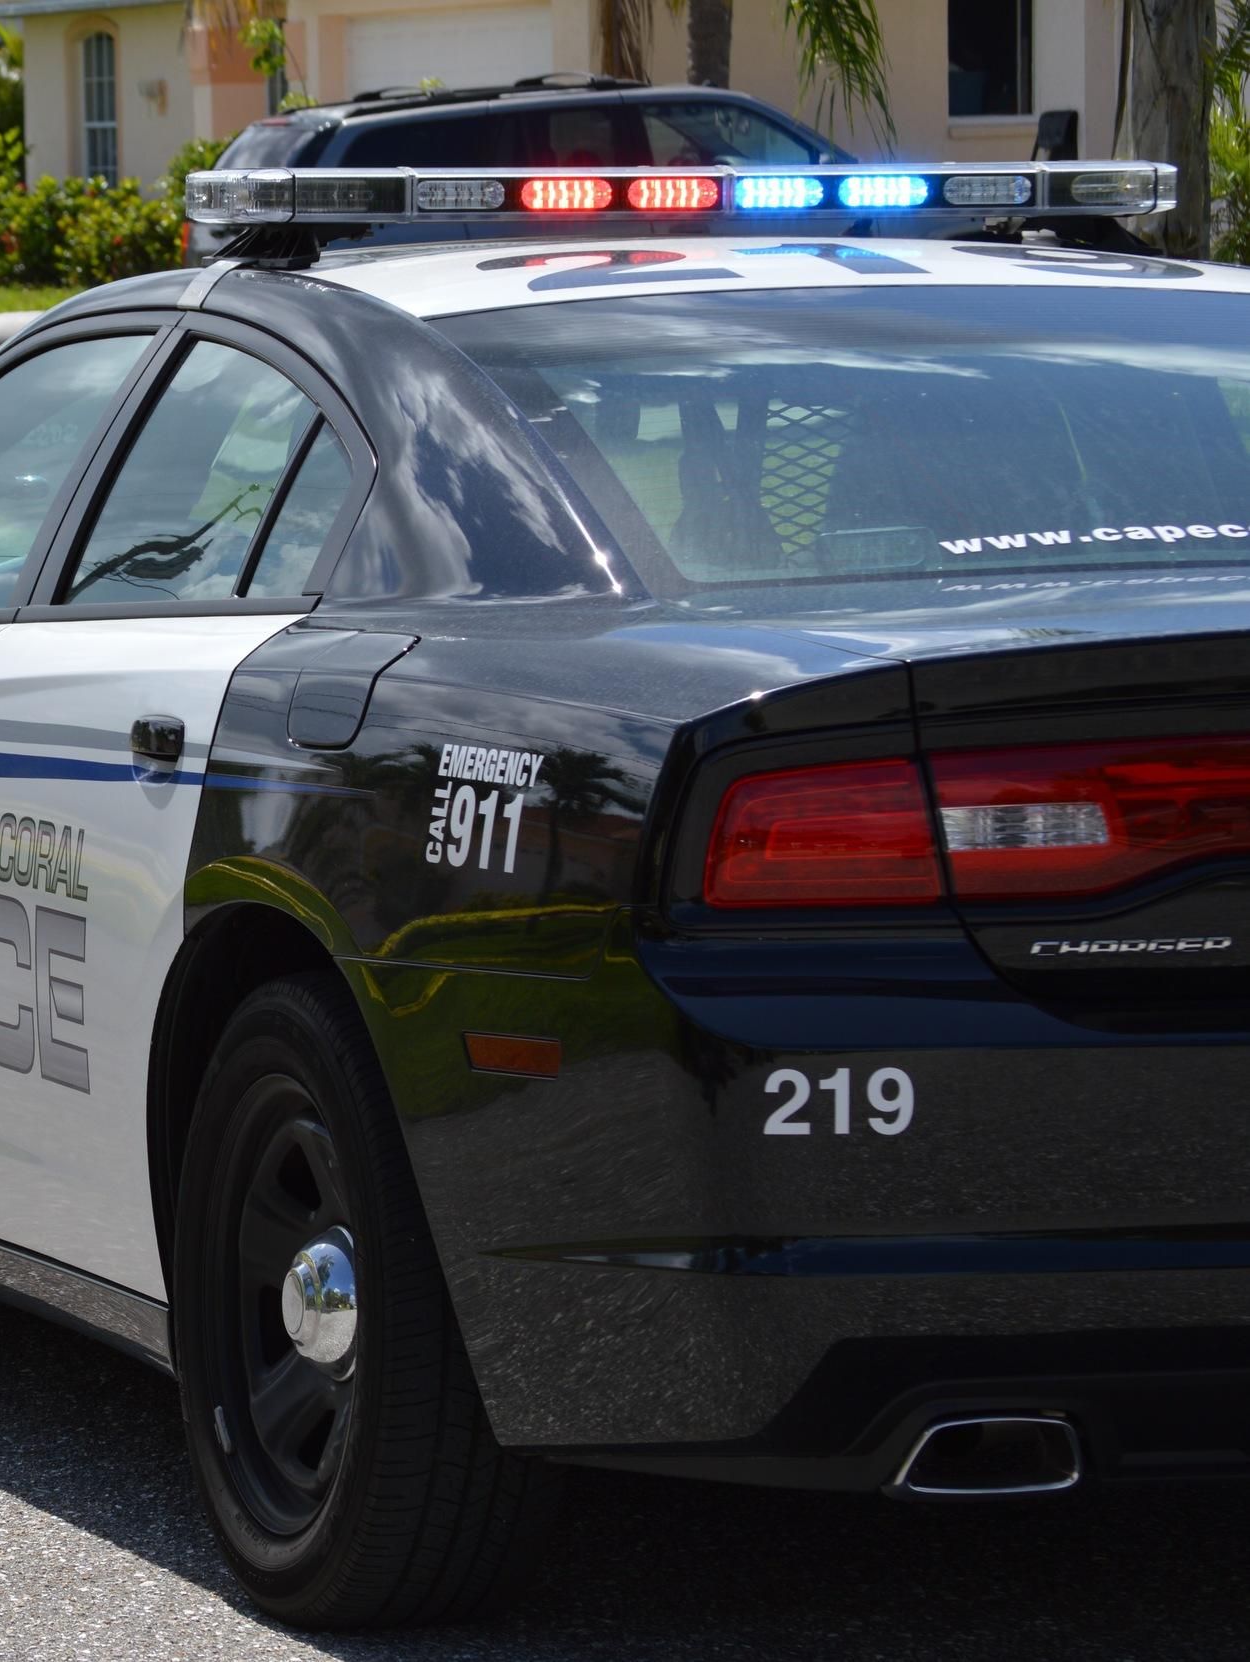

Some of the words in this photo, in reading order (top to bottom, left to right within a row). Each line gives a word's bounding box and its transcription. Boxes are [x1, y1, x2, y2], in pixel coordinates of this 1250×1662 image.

[938, 521, 1250, 555] www.capec
[437, 743, 545, 788] EMERGENCY
[425, 780, 453, 864] CALL
[447, 785, 525, 874] 911
[1029, 935, 1232, 957] CHARGER
[762, 1066, 915, 1136] 219
